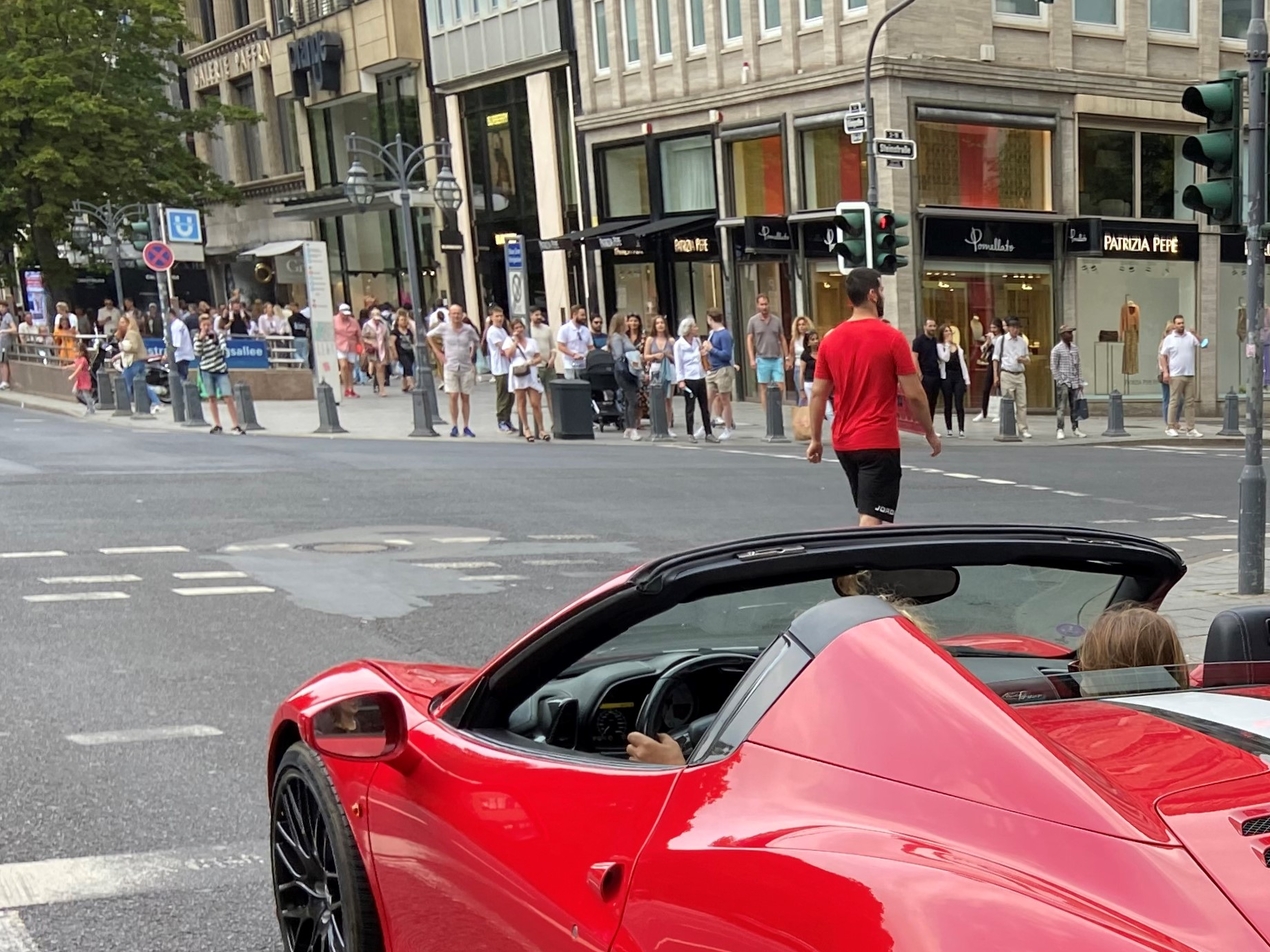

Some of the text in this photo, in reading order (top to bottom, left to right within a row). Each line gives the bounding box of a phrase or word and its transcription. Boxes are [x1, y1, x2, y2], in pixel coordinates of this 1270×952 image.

[964, 227, 1016, 252] Pomellato
[1104, 235, 1151, 251] PATRIZIA
[1153, 236, 1179, 253] PEPE
